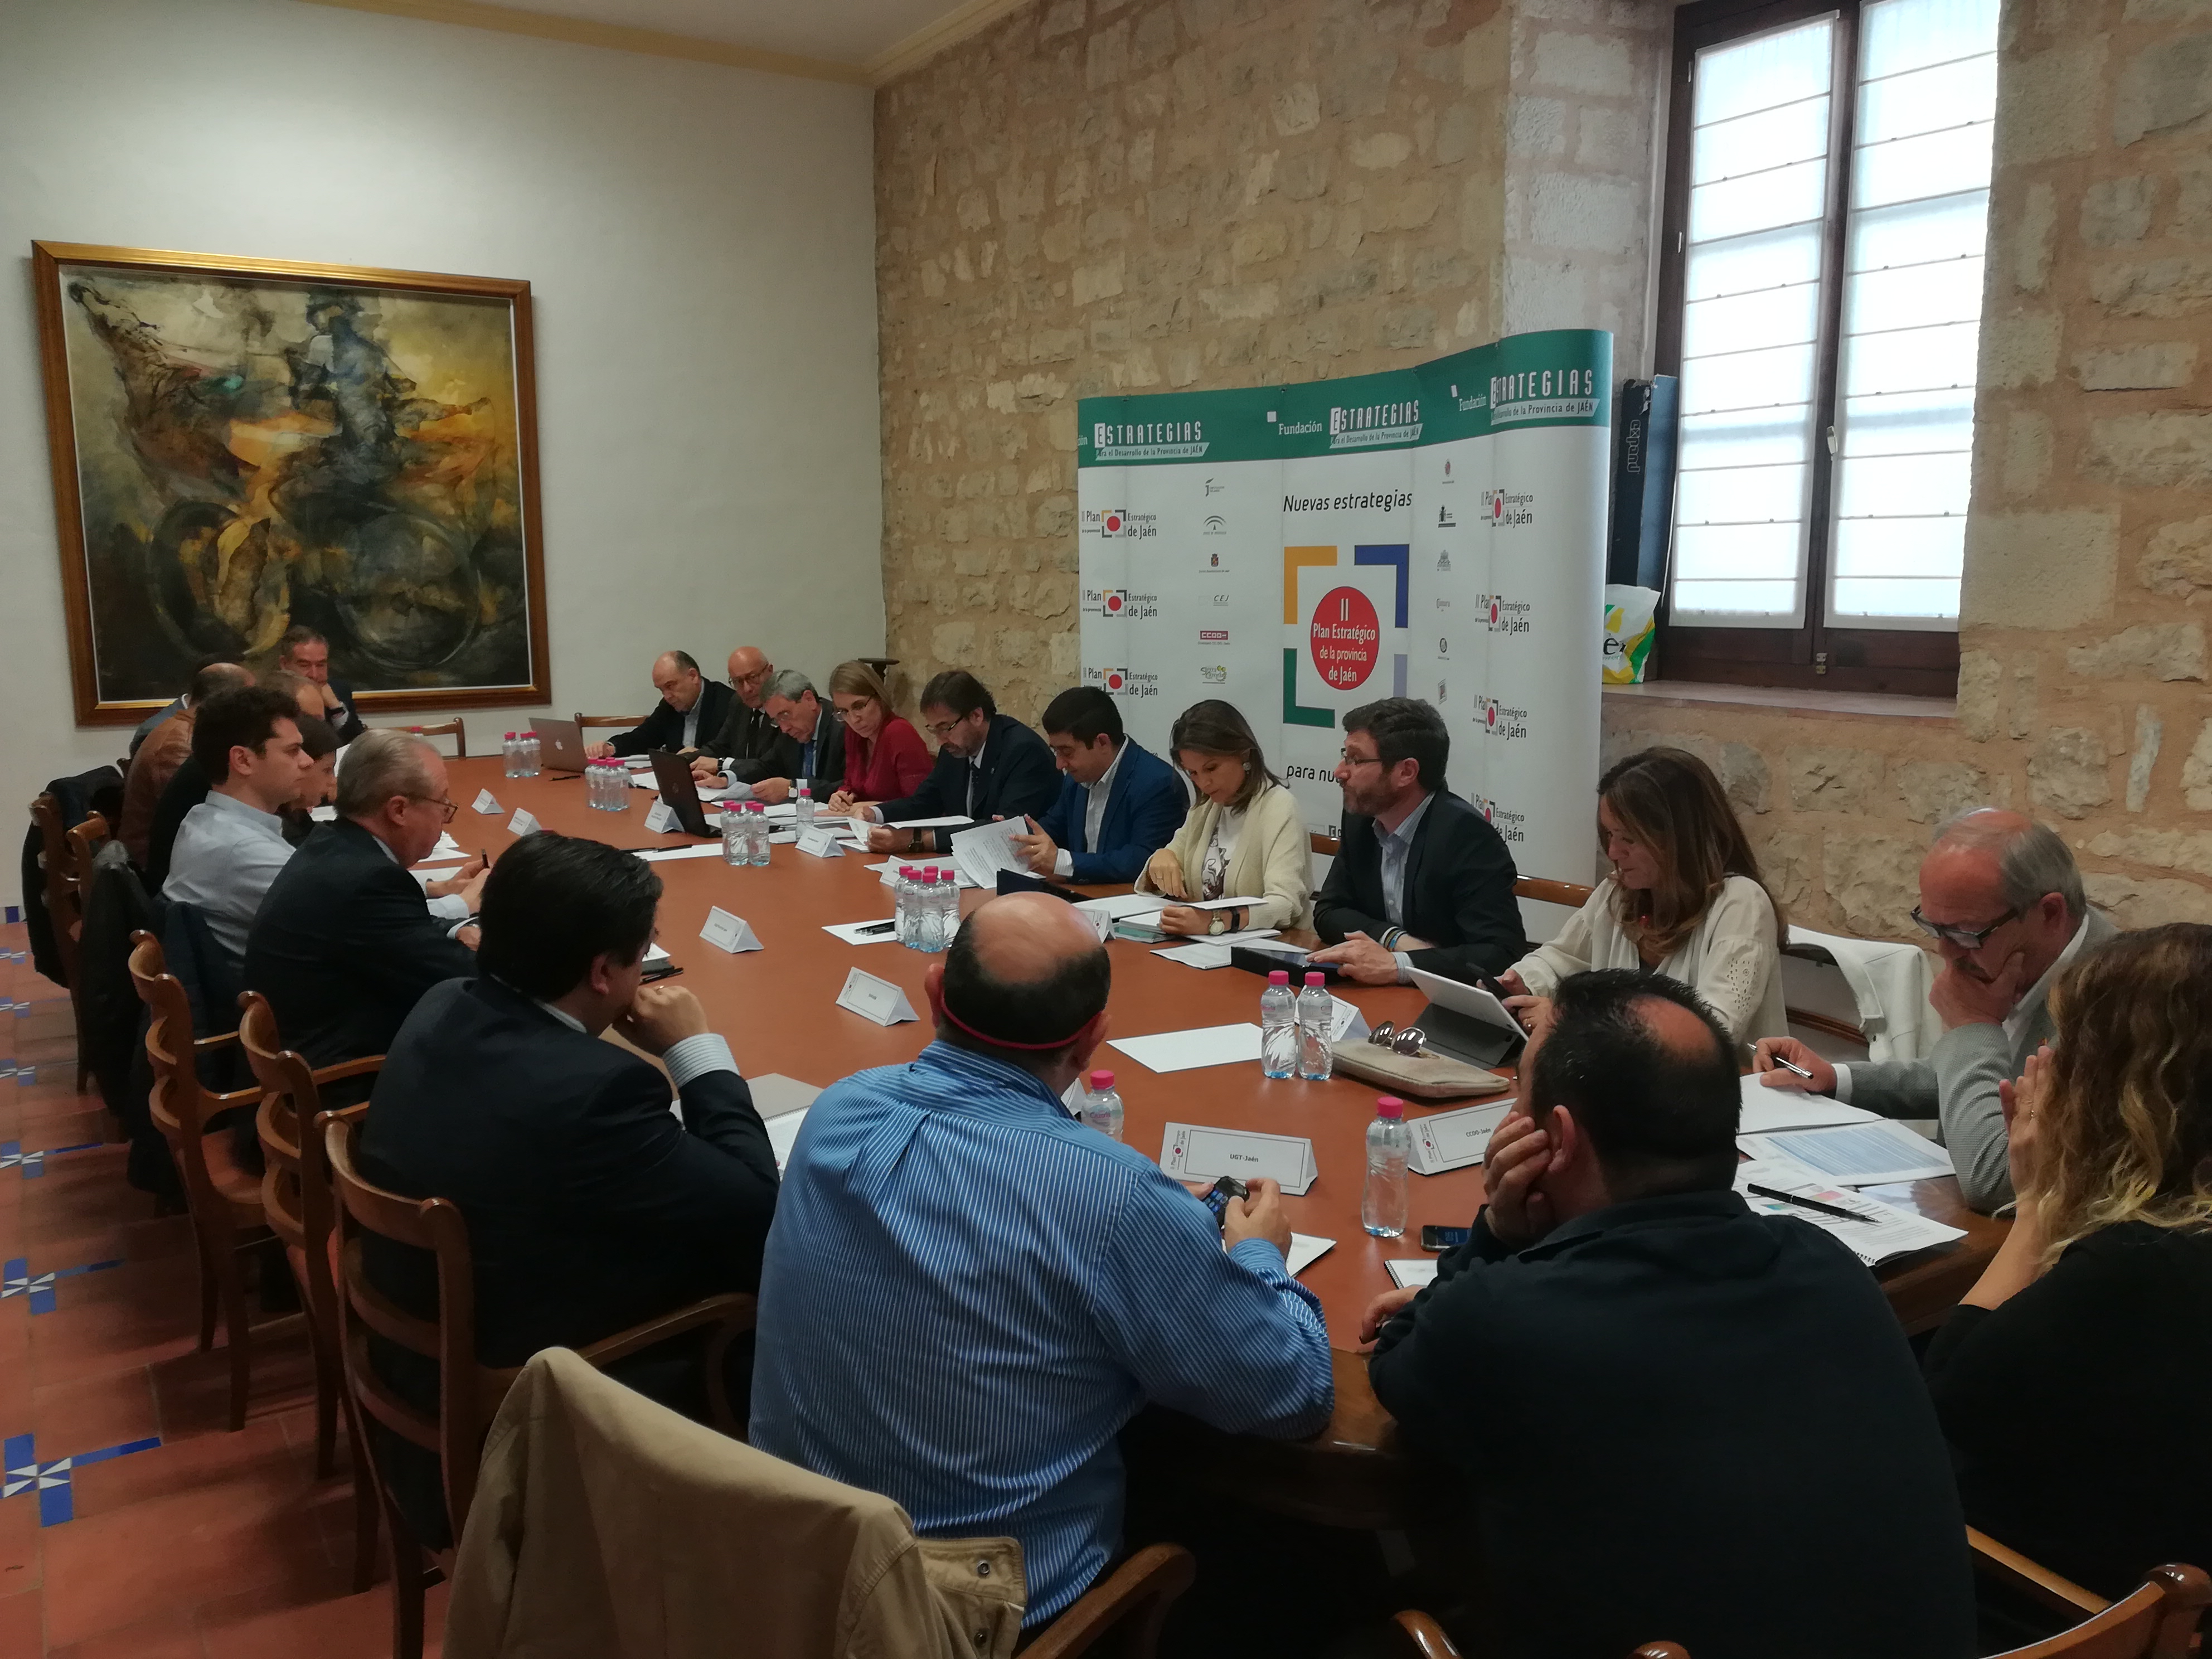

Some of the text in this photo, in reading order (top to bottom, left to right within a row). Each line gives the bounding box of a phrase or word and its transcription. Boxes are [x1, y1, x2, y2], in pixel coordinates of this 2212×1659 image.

[1528, 402, 1563, 414] Provincia
[1565, 402, 1575, 412] de
[1576, 399, 1593, 414] JAÉN
[1278, 399, 1419, 435] Fundación ESTRATEGIAS
[1094, 421, 1202, 448] ESTRATEGIAS
[1114, 448, 1142, 457] Desarrollo
[1626, 419, 1641, 473] expand
[1283, 488, 1413, 512] Nuevas estrategias
[1086, 510, 1100, 522] Plan
[1128, 513, 1157, 524] Estratégico
[1513, 508, 1532, 528] Jaén
[1128, 525, 1157, 540] de Jaén
[1087, 590, 1102, 601] Plan
[1128, 593, 1157, 604] Estratégico
[1128, 605, 1157, 620] de Jaén
[1341, 598, 1350, 621] II
[1313, 623, 1376, 644] Plan Estratégico
[1502, 616, 1530, 636] de Jaén
[1320, 645, 1367, 664] de la provincia
[1088, 667, 1102, 678] Plan
[1129, 672, 1158, 683] Estratégico
[1328, 665, 1357, 685] de Jaén
[1129, 683, 1158, 698] de Jaén
[1498, 721, 1526, 741] de Jaén
[1287, 765, 1315, 780] para
[1496, 807, 1525, 824] Estratégico
[1504, 824, 1524, 842] Jaén
[1230, 1153, 1259, 1163] UGT-Jaén
